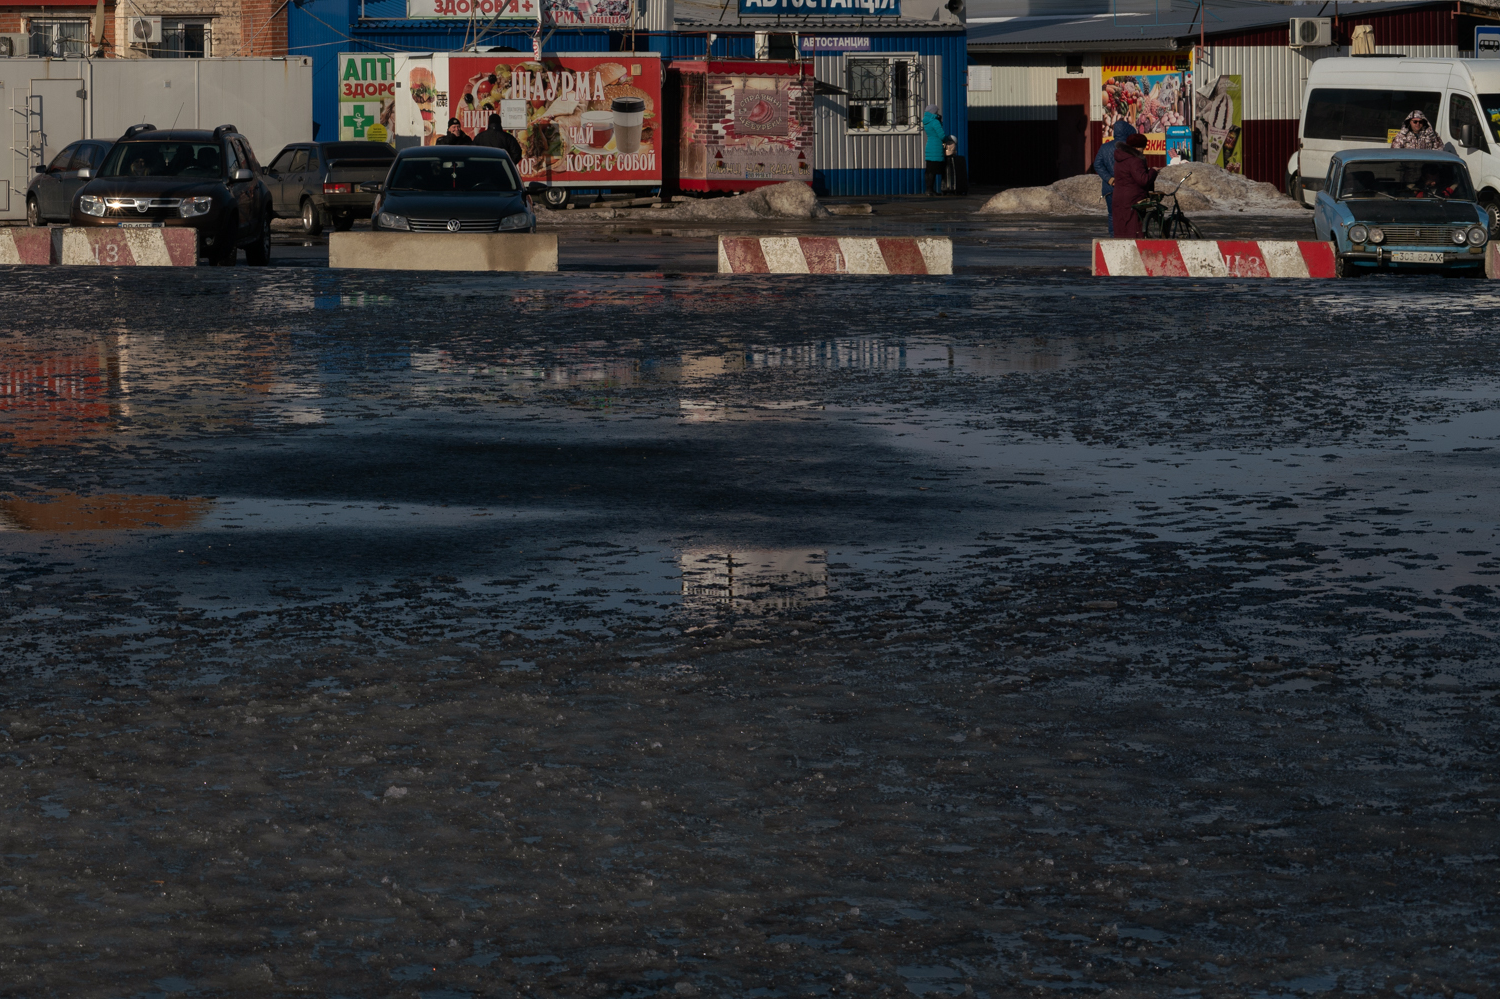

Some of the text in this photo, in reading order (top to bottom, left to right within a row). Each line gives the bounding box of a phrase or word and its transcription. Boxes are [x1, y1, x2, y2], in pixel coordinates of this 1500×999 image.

[544, 10, 585, 24] УРМА
[803, 37, 870, 48] АВТОСТАНЦИЯ
[343, 58, 395, 81] АПТ
[1103, 55, 1138, 72] МИНИ
[511, 71, 605, 101] ШАУРМА
[569, 122, 594, 145] ЧАЙ
[1145, 139, 1166, 151] ЗКИЕ
[516, 149, 656, 176] ОГ КОФЕ С СОБОЙ
